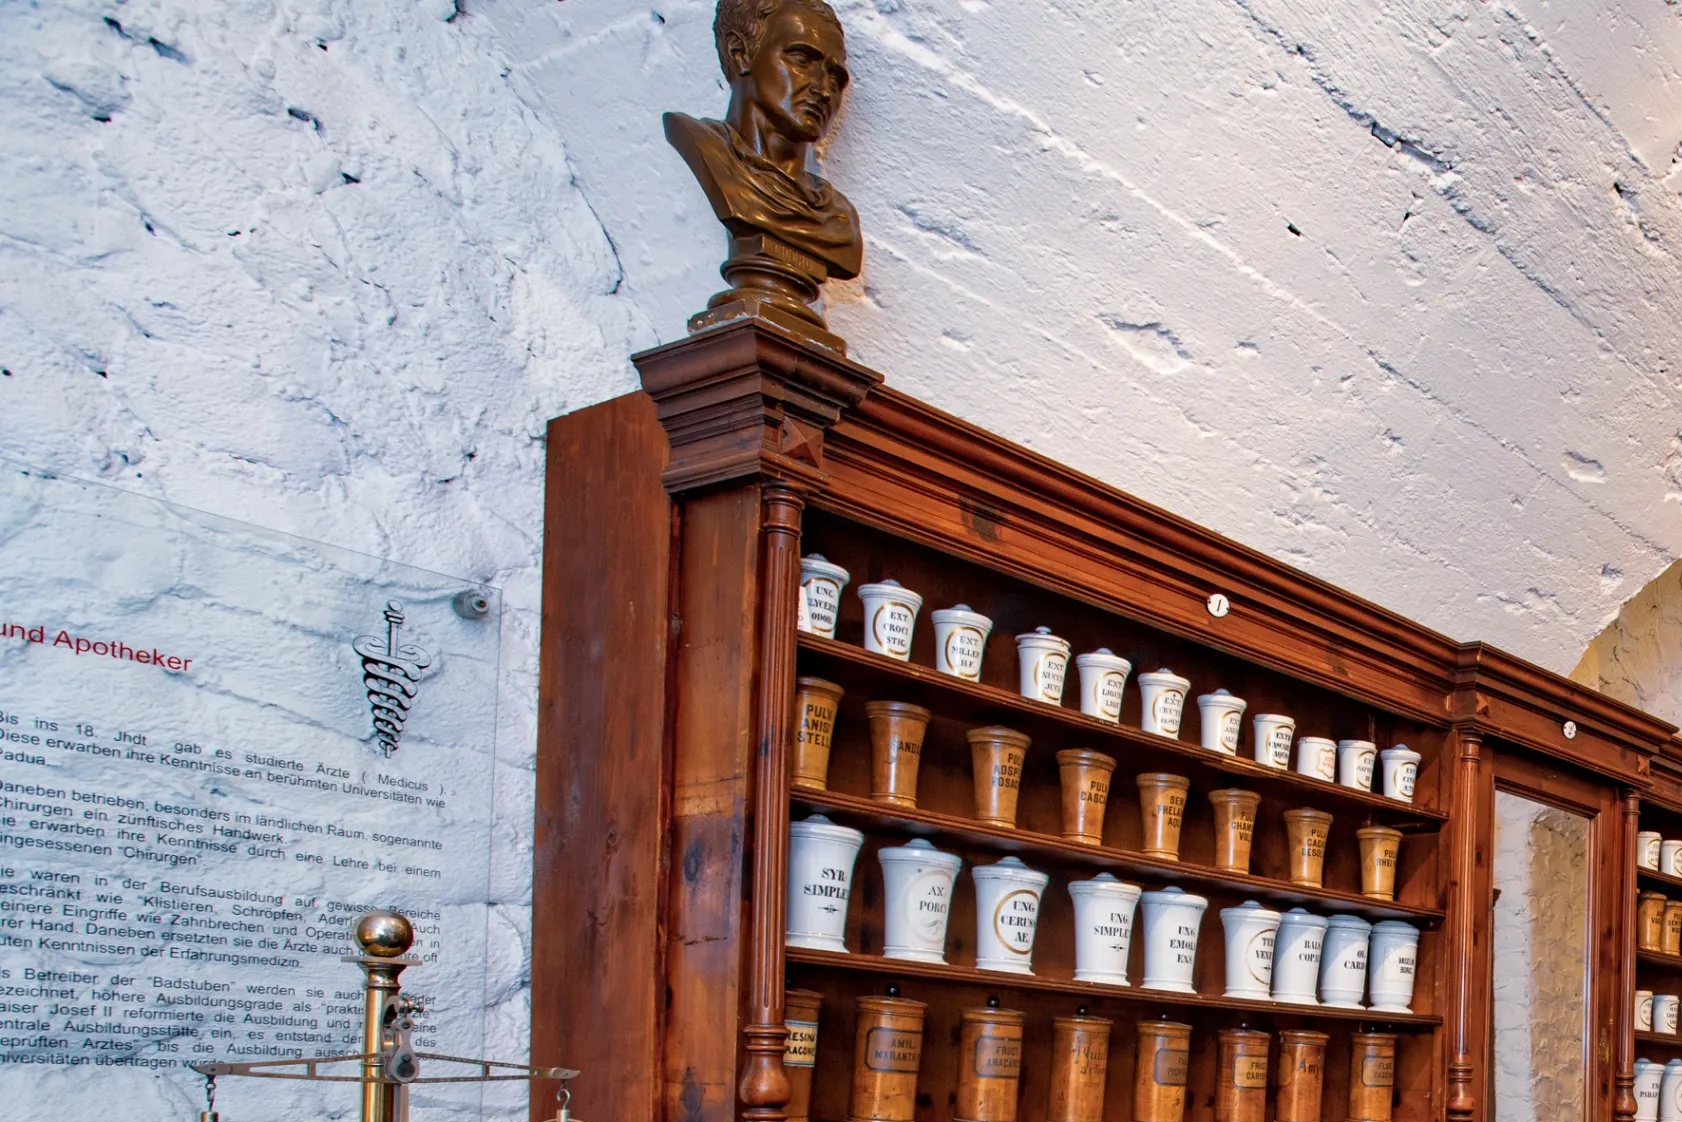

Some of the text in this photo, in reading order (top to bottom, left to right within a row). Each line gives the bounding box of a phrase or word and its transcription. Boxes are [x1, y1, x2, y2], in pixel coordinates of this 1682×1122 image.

[54, 630, 192, 671] Apotheker
[35, 717, 428, 792] ins 18. Jhdt gab es studierte Ärzte Medicus
[46, 738, 120, 758] erwarben
[126, 749, 155, 763] ihre
[160, 753, 241, 777] Kenntnisse
[245, 769, 261, 780] an
[267, 771, 338, 792] berühmten
[342, 783, 422, 805] Universitäten
[426, 798, 446, 809] wie
[72, 790, 149, 812] betrieben,
[155, 801, 230, 822] besonders
[235, 812, 252, 825] im
[256, 815, 323, 834] ländlichen
[373, 832, 443, 851] sogenannte
[84, 810, 108, 821] ein
[118, 814, 203, 834] zünftisches
[213, 825, 288, 845] Handwerk.
[29, 819, 441, 879] erwarben ihre Kenntnisse durch eine Lehre bei einem
[30, 870, 316, 908] waren in der Berufsausbildung auf
[96, 894, 123, 904] wie
[63, 905, 297, 936] Eingriffe wie Zahnbrechen und
[31, 918, 79, 933] Hand.
[86, 923, 155, 939] Daneben
[161, 930, 228, 946] ersetzten
[233, 938, 253, 947] sie
[260, 938, 278, 949] die
[323, 945, 353, 956] auch
[39, 938, 304, 969] Kenntnissen der Erfahrungsmedizin.
[25, 968, 324, 998] Betreiber der werden sie
[50, 1004, 96, 1017] Josef
[124, 1009, 204, 1022] reformierte
[214, 1013, 235, 1023] die
[244, 1013, 323, 1029] Ausbildung
[327, 1019, 351, 1029] und
[92, 990, 146, 1003] höhere
[155, 992, 283, 1011] Ausbildungsgrade
[293, 1002, 312, 1013] als
[64, 1020, 199, 1038] Ausbildungsstätte
[248, 1030, 264, 1040] es
[276, 1031, 331, 1043] entstand
[415, 1037, 436, 1047] des
[95, 1055, 176, 1070] übertragen
[158, 1041, 302, 1058] bis die Ausbildung
